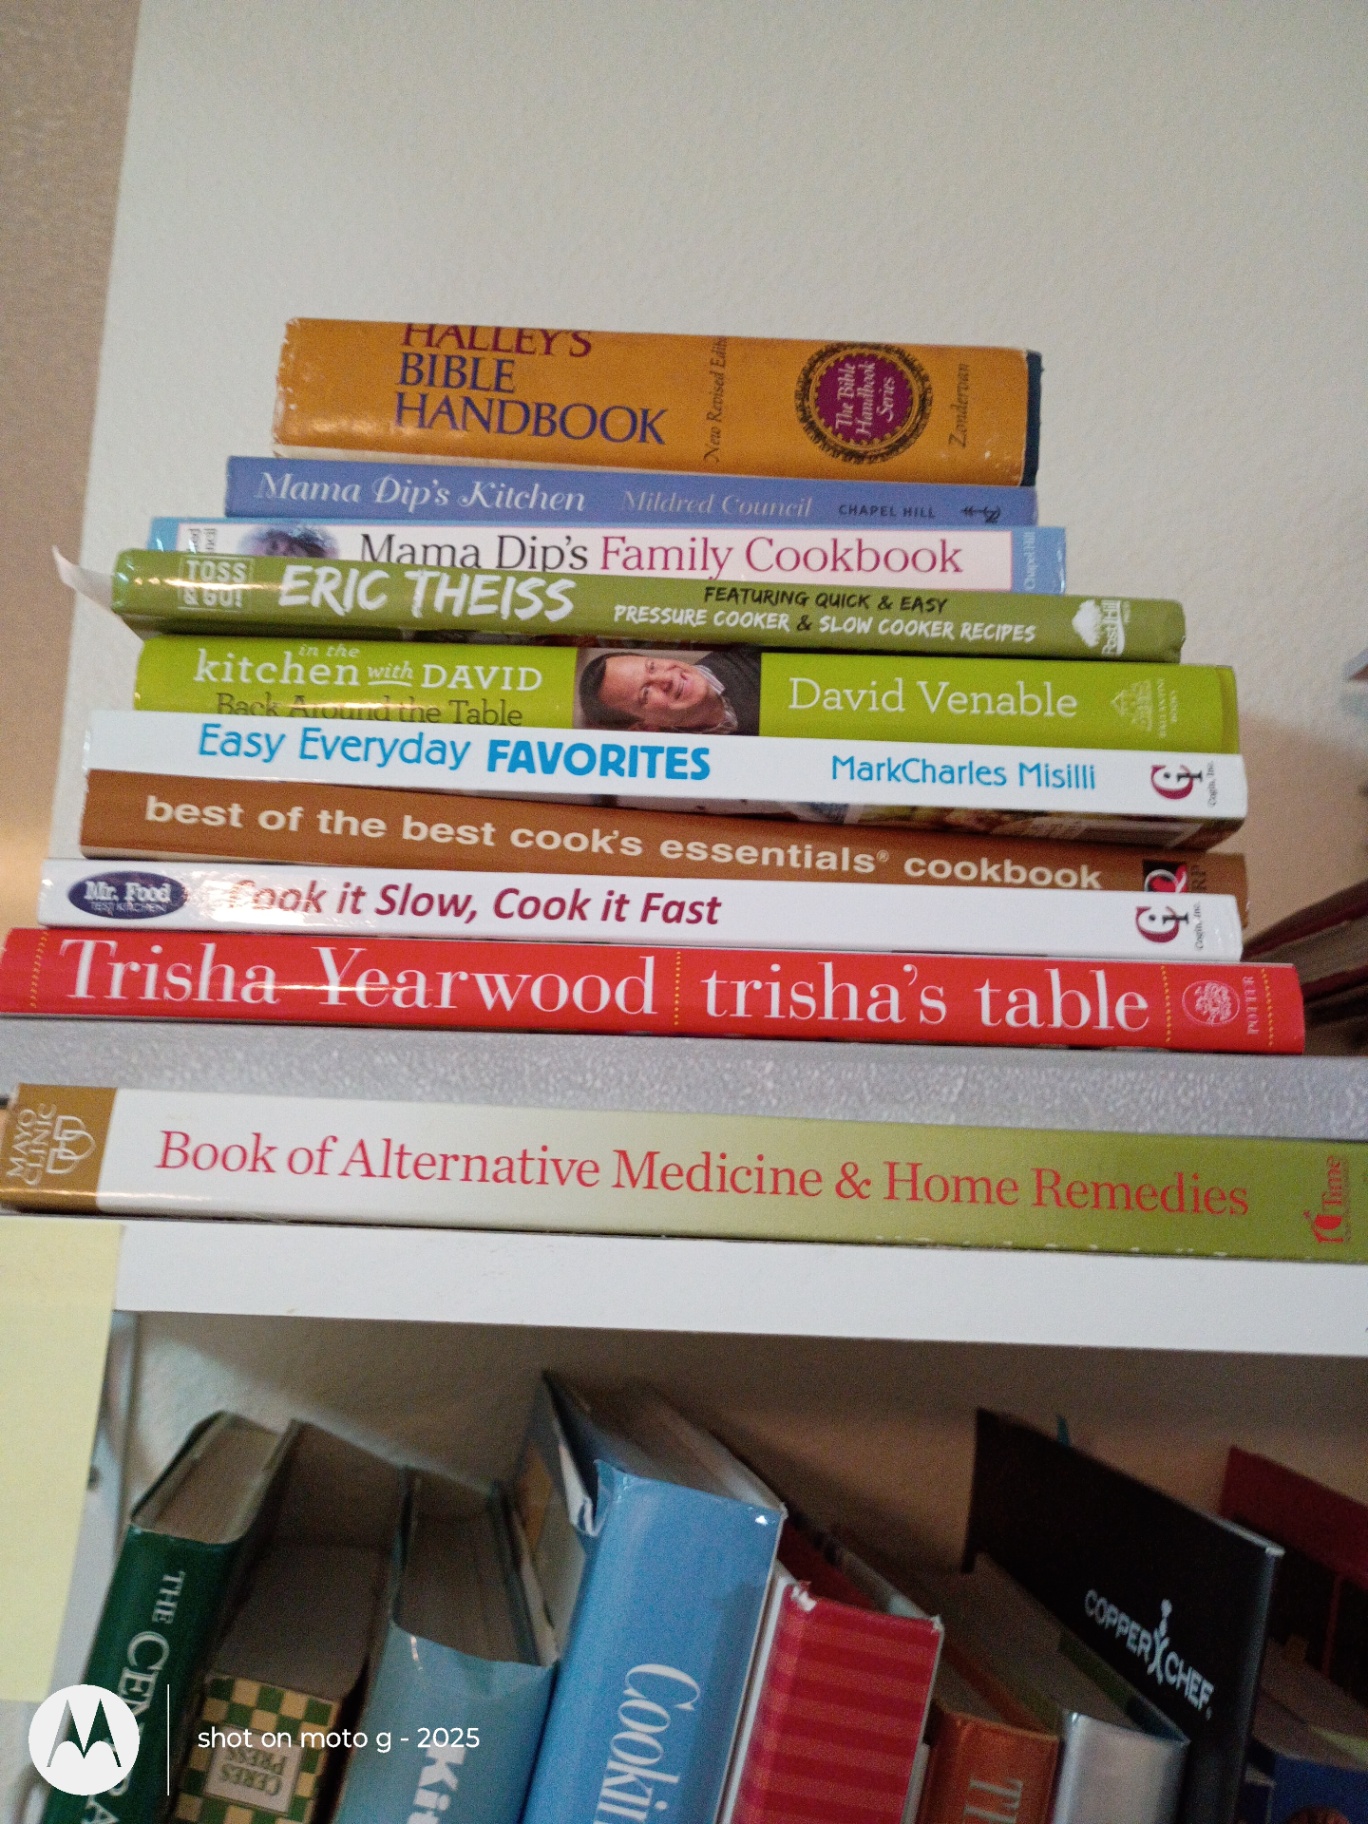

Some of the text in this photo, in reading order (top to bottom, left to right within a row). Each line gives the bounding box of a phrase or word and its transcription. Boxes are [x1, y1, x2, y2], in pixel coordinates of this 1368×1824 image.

[402, 323, 592, 358] HALLEY'S
[399, 352, 516, 394] BIBLE
[706, 369, 726, 422] Revised
[835, 362, 856, 430] The Bible
[394, 391, 668, 446] HANDBOOK
[855, 361, 876, 438] Handbook
[876, 376, 896, 423] Series
[948, 363, 970, 449] Zondervan
[703, 425, 722, 463] New
[254, 472, 586, 513] Mama Dip's Kitchen
[620, 490, 813, 518] Mildred Council
[838, 503, 936, 519] CHAPEL HILL
[186, 560, 248, 584] TOSS
[361, 533, 963, 581] Mama Dip's Family Cookbook
[279, 564, 578, 623] ERIC THEISS
[703, 586, 948, 615] FEATURING QUICK & EASY
[613, 604, 1037, 643] PRESSURE COOKER & SLOW COOKER RECIPES
[193, 649, 543, 692] kitchen with DAVID
[299, 643, 361, 658] in the
[216, 692, 523, 728] Back Around the Table
[788, 677, 1078, 719] David Venable
[197, 722, 711, 781] Easy Everyday FAVORITES
[832, 755, 1096, 790] MarkCharles Misilli
[145, 795, 245, 828] best
[258, 806, 304, 832] of
[316, 808, 388, 839] the
[402, 815, 497, 848] best
[509, 827, 644, 857] cook's
[903, 856, 1103, 890] cookbook
[84, 880, 172, 904] Mr. Food
[228, 879, 722, 925] Cook it Slow, Cook it Fast
[60, 938, 1150, 1031] Trisha Yearwood trisha's table
[6, 1108, 37, 1178] MAYO
[21, 1103, 57, 1186] CLINIC
[155, 1130, 1250, 1217] Book of Alternative Medicine & Home Remedies
[1321, 1154, 1342, 1213] Time
[151, 1569, 187, 1625] THE
[1084, 1589, 1215, 1711] COPPER CHEF
[594, 1662, 701, 1824] Cooki
